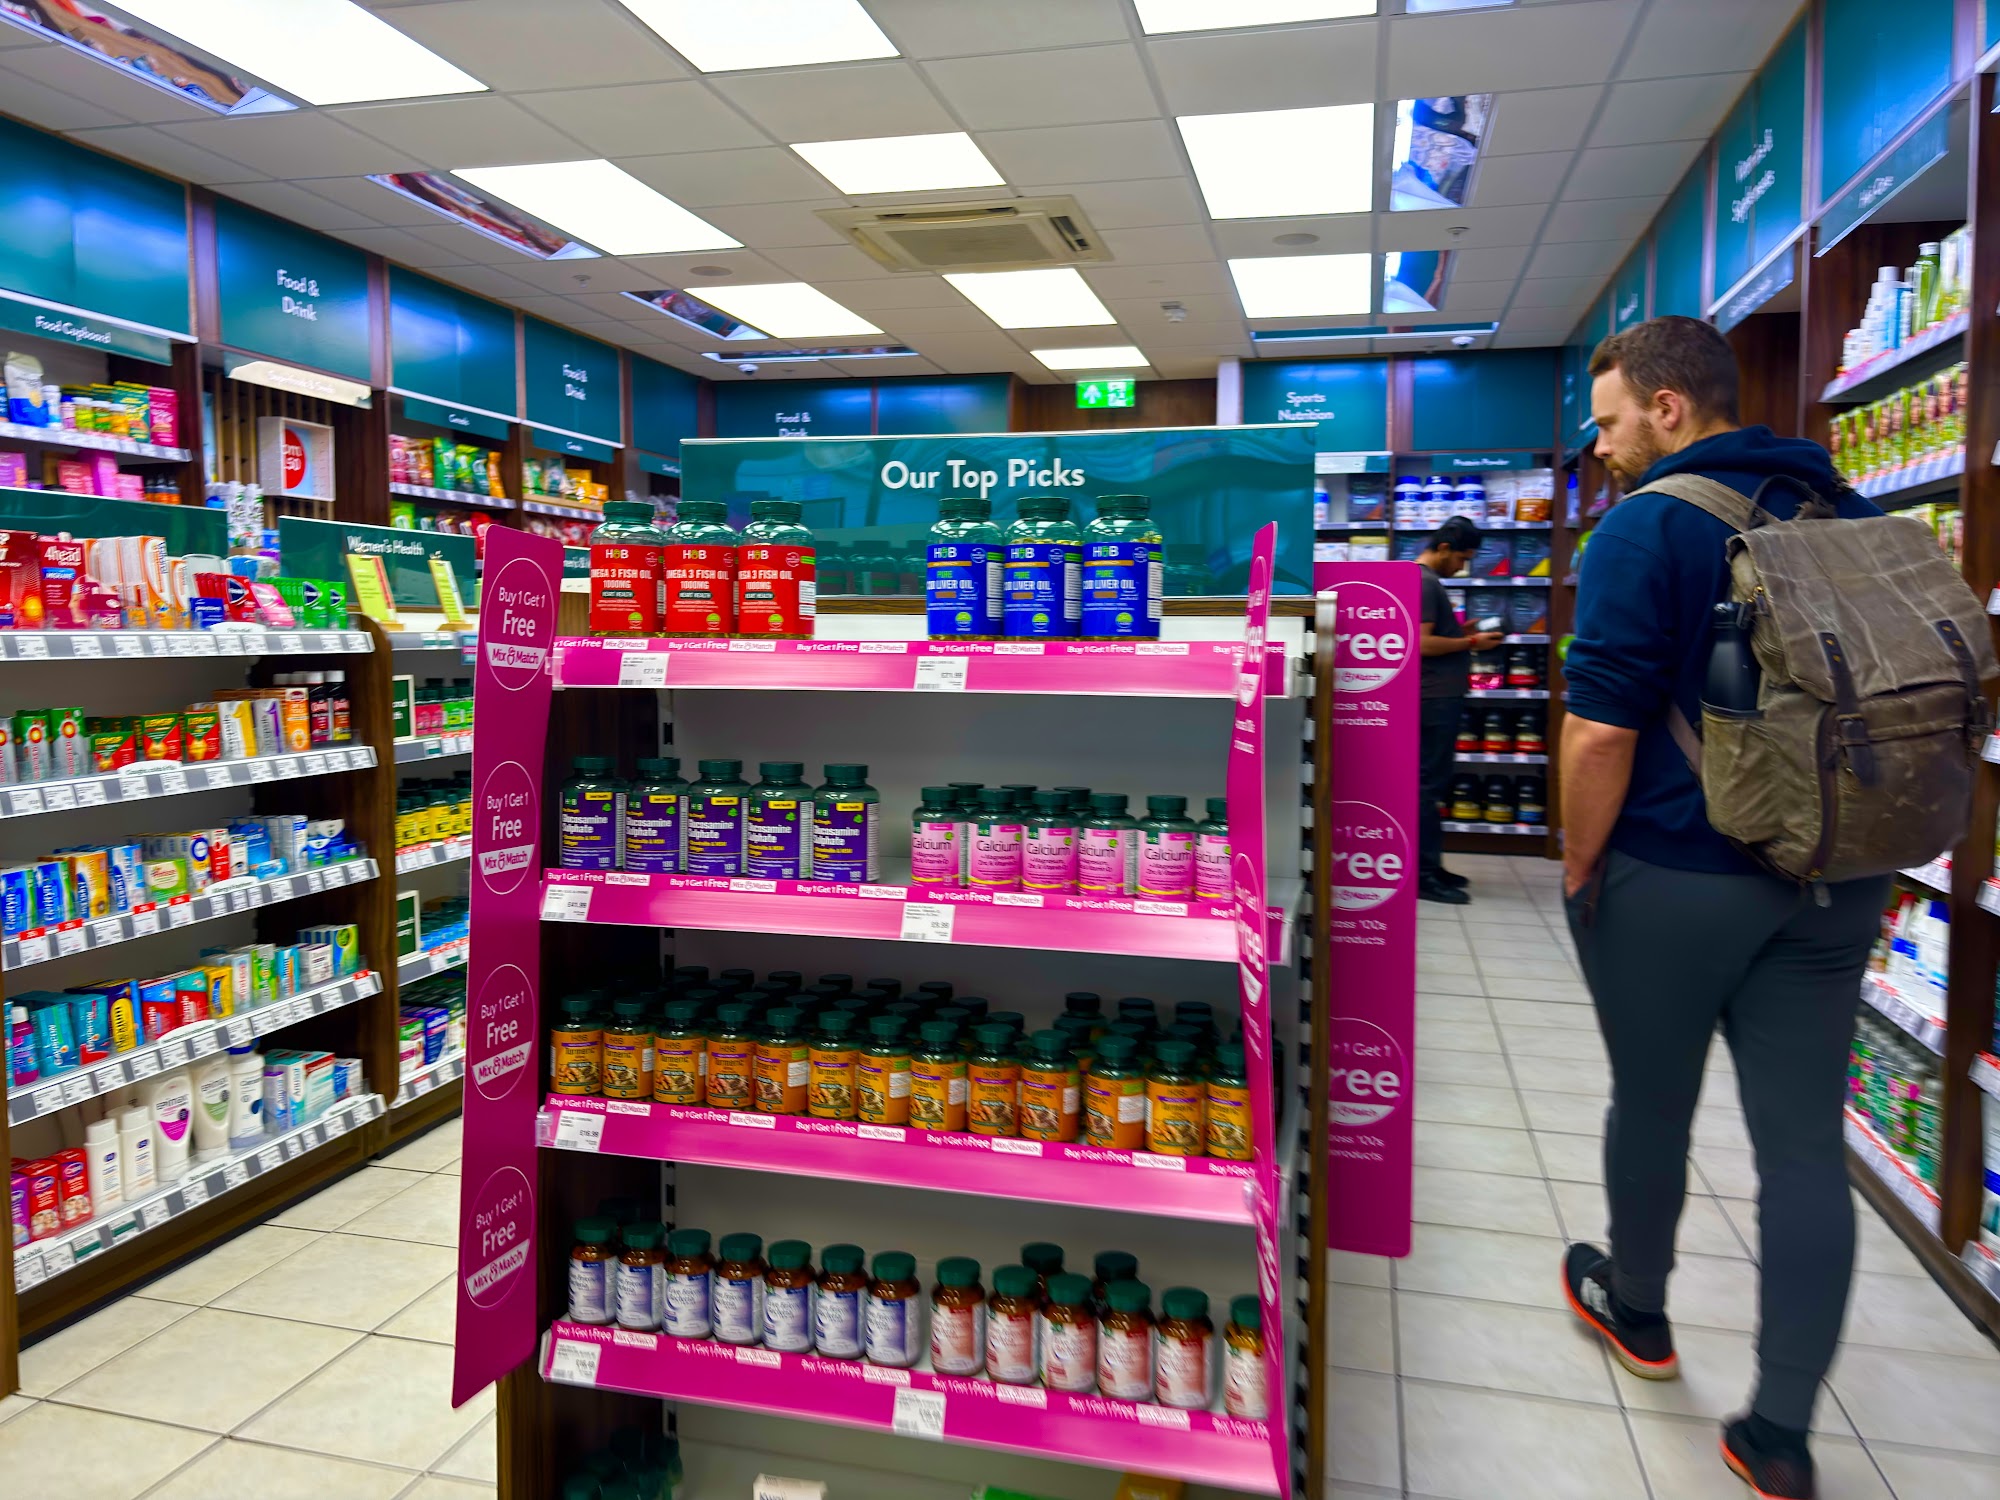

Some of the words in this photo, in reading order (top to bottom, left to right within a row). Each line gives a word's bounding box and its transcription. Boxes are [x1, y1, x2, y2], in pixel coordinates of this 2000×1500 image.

[276, 269, 307, 292] Food
[307, 279, 320, 298] &
[282, 296, 317, 321] Drink
[35, 315, 61, 334] Food
[1286, 392, 1327, 406] Sports
[776, 412, 799, 423] Food
[801, 412, 811, 423] &
[1278, 409, 1335, 421] Nutrition
[881, 460, 940, 489] Our
[947, 459, 998, 498] Top
[1007, 458, 1086, 488] Picks
[44, 545, 82, 561] 4head
[347, 536, 391, 555] Women's
[392, 541, 424, 556] Health
[591, 569, 610, 578] MEGA
[610, 569, 617, 578] 3
[617, 569, 638, 578] FISH
[640, 570, 652, 579] OIL
[666, 570, 687, 579] MEGA
[688, 569, 694, 578] 3
[696, 570, 716, 579] FISH
[717, 570, 729, 580] OIL
[752, 570, 758, 579] 3
[759, 570, 778, 579] FISH
[780, 570, 794, 580] OIL
[603, 580, 632, 588] 1000MG
[680, 581, 709, 589] 1000MG
[746, 581, 771, 589] 1000MG
[936, 580, 958, 589] LIVER
[959, 580, 974, 589] OIL
[1013, 581, 1035, 590] LIVER
[1036, 581, 1052, 590] OIL
[1094, 580, 1119, 589] LIVER
[1120, 580, 1136, 589] OIL
[499, 587, 517, 605] Buy
[518, 590, 523, 604] 1
[524, 591, 540, 606] Get
[540, 594, 545, 608] 1
[1346, 607, 1354, 619] 1
[1356, 607, 1386, 619] Get
[1387, 607, 1396, 619] 1
[502, 610, 536, 637] Free
[669, 642, 684, 650] Buy
[706, 641, 728, 649] Free
[836, 643, 858, 651] Free
[929, 645, 945, 653] Buy
[970, 644, 993, 652] Free
[492, 648, 507, 661] Mix
[515, 651, 539, 665] Match
[487, 795, 502, 809] Buy
[502, 794, 508, 807] 1
[508, 792, 524, 807] Get
[524, 791, 529, 805] 1
[492, 813, 522, 840] Free
[1345, 827, 1352, 839] 1
[1354, 826, 1385, 840] Get
[1386, 827, 1394, 839] 1
[976, 840, 1020, 852] Calcium
[1026, 843, 1071, 855] Calcium
[484, 856, 499, 871] Mix
[505, 850, 529, 867] Match
[1144, 848, 1192, 862] Calcium
[547, 872, 561, 882] Buy
[566, 873, 580, 881] Get
[584, 872, 604, 882] Free
[480, 1003, 498, 1020] Buy
[498, 1000, 503, 1013] 1
[503, 995, 520, 1010] Get
[520, 991, 525, 1004] 1
[486, 1018, 518, 1049] Free
[1352, 1043, 1381, 1057] Get
[1384, 1045, 1391, 1057] 1
[478, 1062, 493, 1081] Mix
[500, 1050, 526, 1070] Match
[475, 1208, 494, 1230] Buy
[494, 1205, 500, 1219] 1
[500, 1198, 518, 1214] Get
[518, 1190, 523, 1203] 1
[481, 1219, 517, 1257] Free
[472, 1268, 490, 1288] Mix
[497, 1248, 524, 1272] Match
